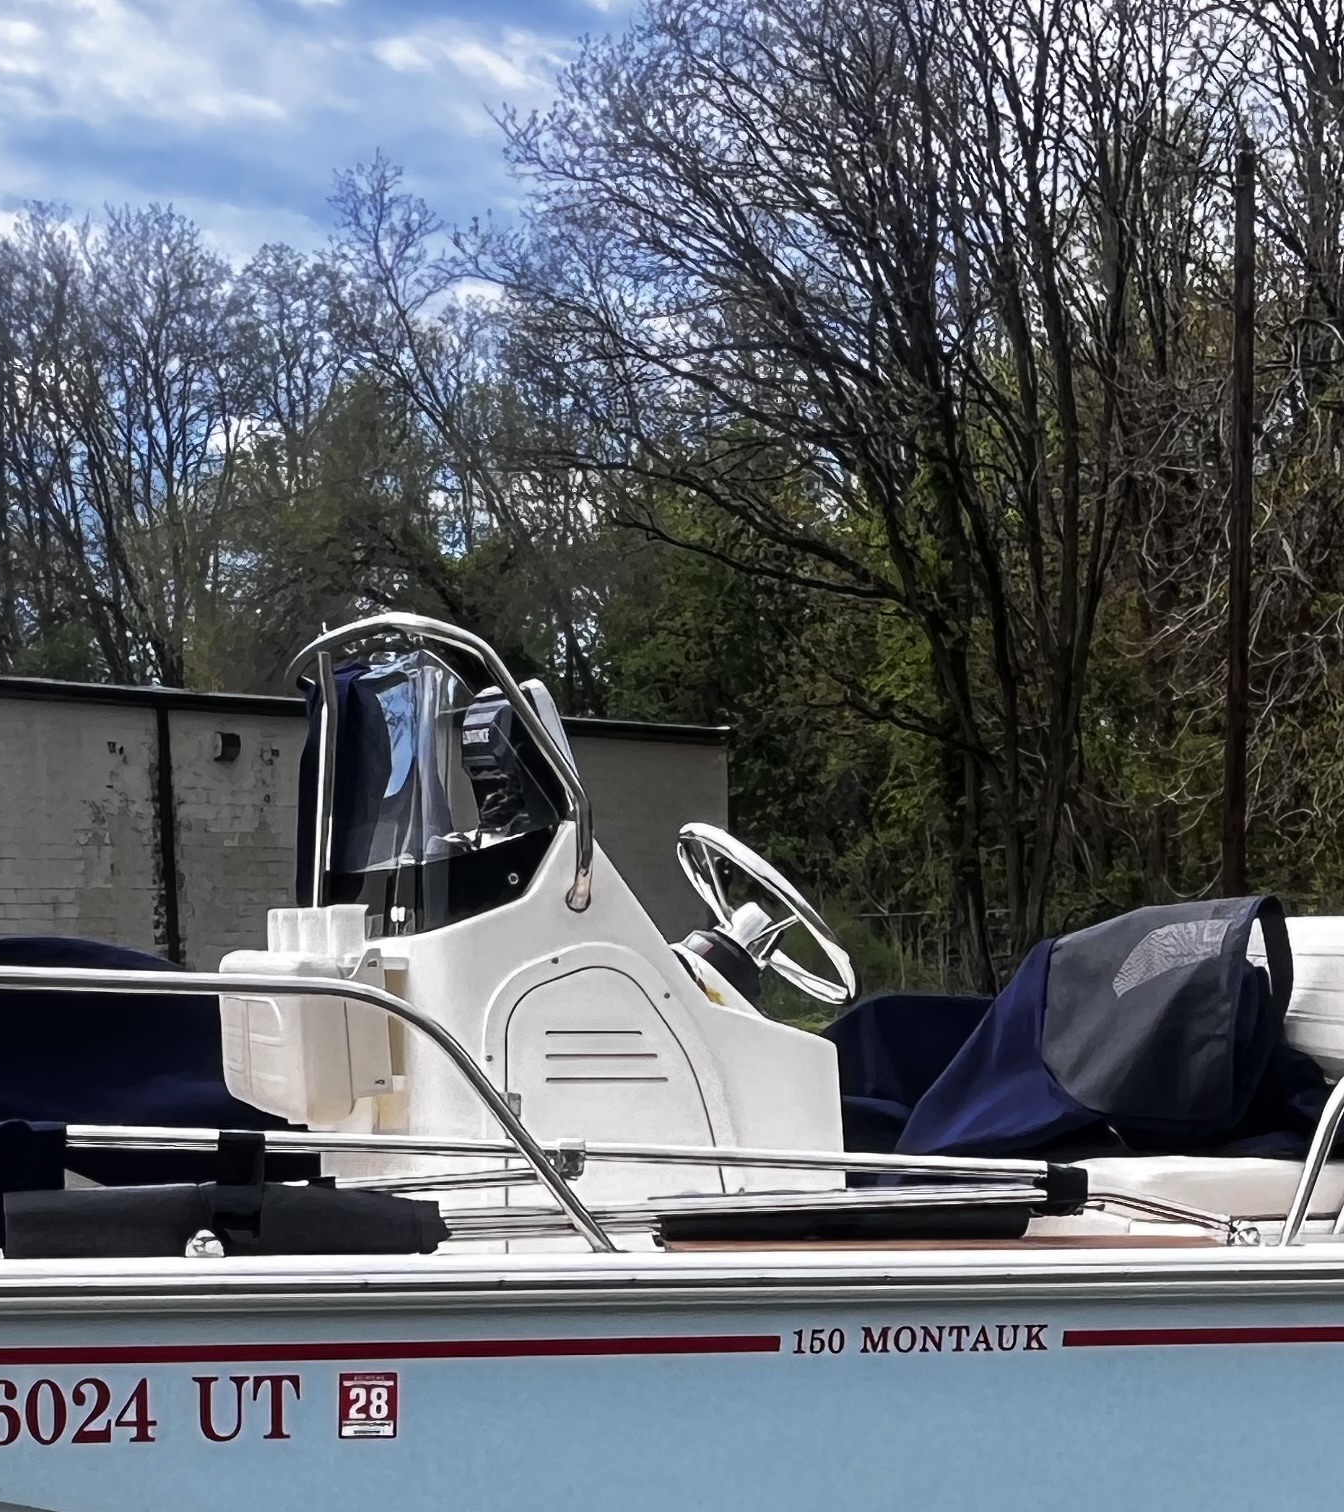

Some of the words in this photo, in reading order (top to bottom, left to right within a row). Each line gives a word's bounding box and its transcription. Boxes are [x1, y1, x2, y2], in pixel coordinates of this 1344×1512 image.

[792, 1328, 846, 1353] 150
[860, 1324, 1049, 1353] MONTAUK
[191, 1375, 301, 1442] UT
[348, 1387, 389, 1419] 28
